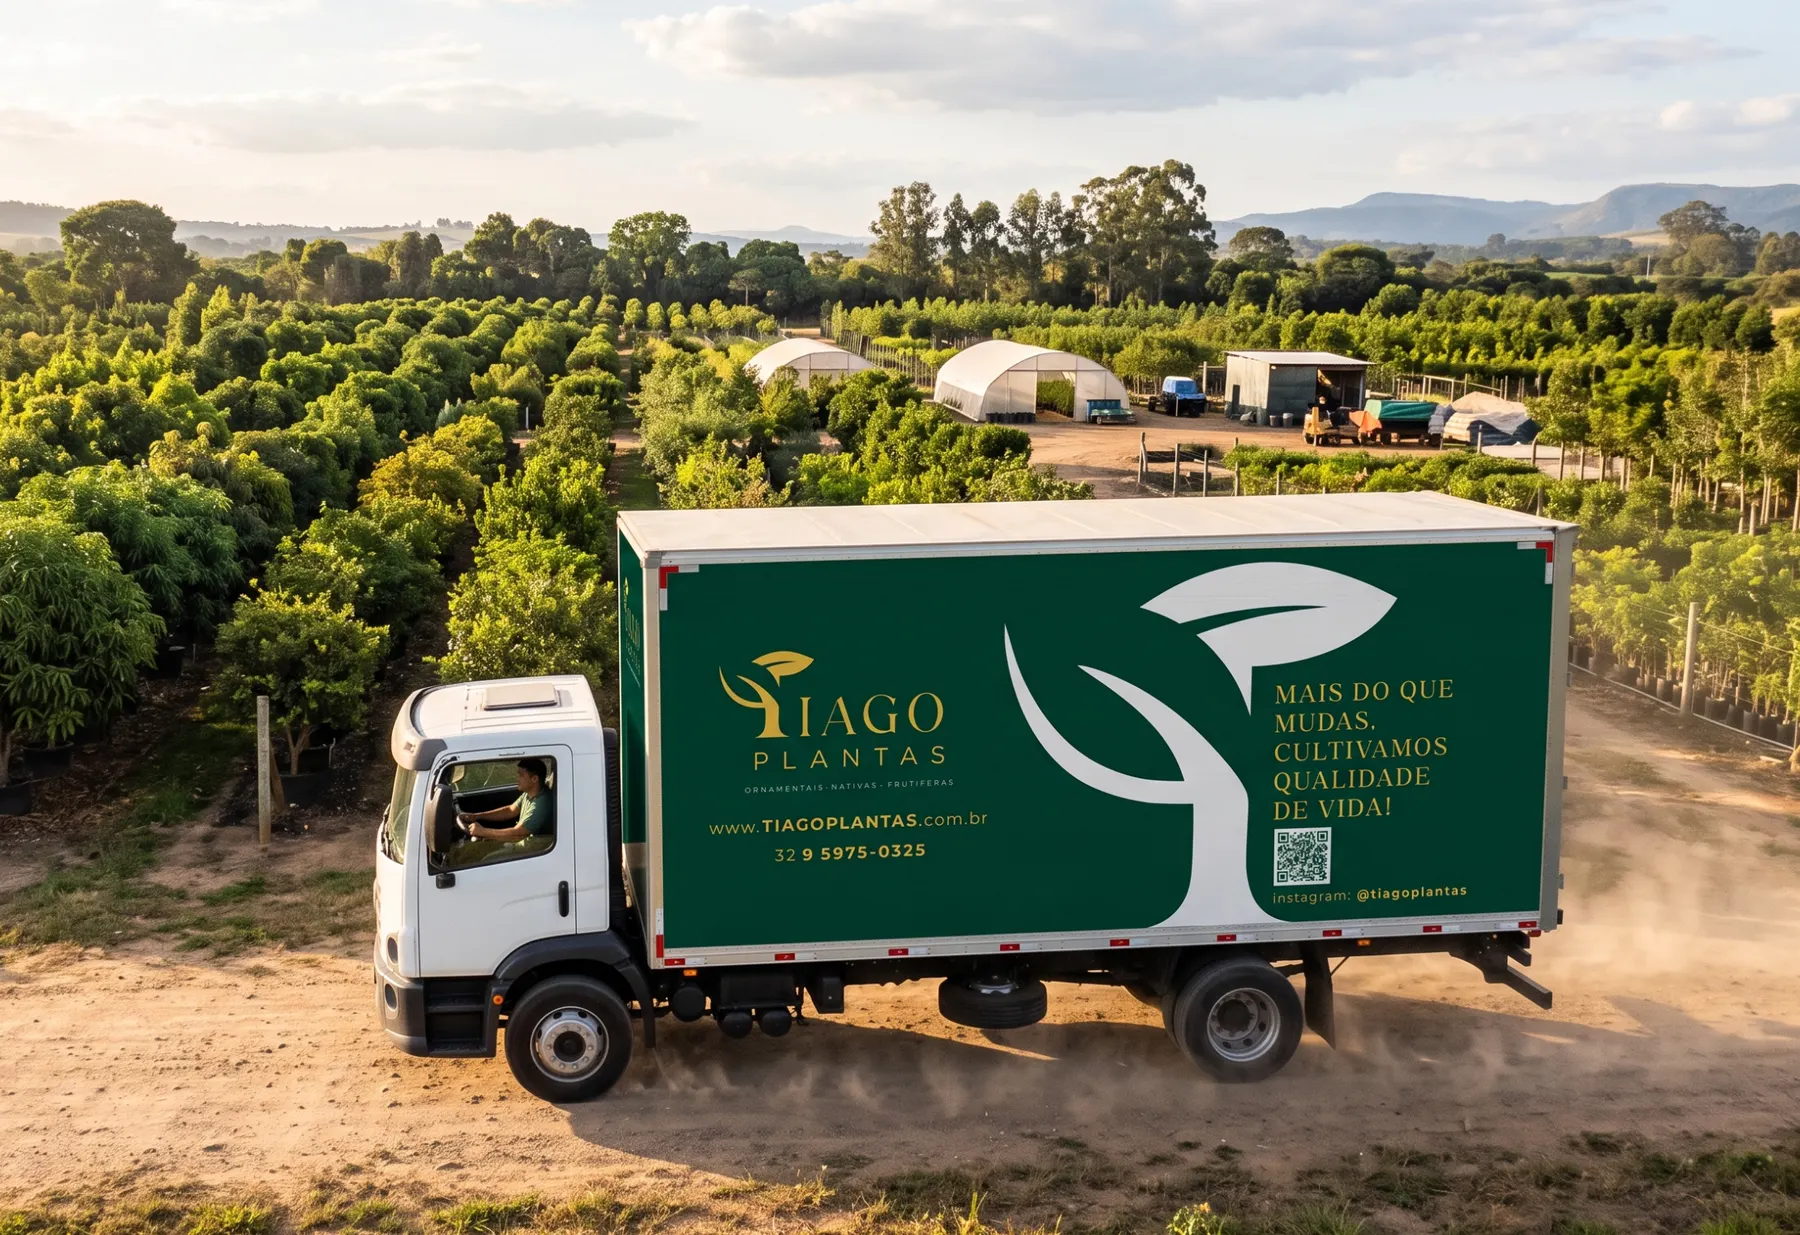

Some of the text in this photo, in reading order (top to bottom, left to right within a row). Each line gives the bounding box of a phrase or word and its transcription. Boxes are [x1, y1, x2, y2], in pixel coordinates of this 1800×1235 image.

[719, 651, 944, 738] TIAGO
[1275, 679, 1454, 704] MAIS DO QUE
[1274, 711, 1376, 733] MUDAS,
[753, 745, 946, 771] PLANTAS
[1274, 736, 1448, 762] CULTIVAMOS
[744, 779, 954, 794] ORNAMENTAIS NATIVAS FRUTIFERAS
[1273, 766, 1431, 795] QUALIDADE
[1273, 796, 1392, 821] DE VIDA!
[708, 811, 988, 835] www.TIAGOPLANTAS.com.br
[774, 843, 926, 862] 32 9 5975-0325
[1273, 885, 1468, 904] instagram: @tiagoplantas
